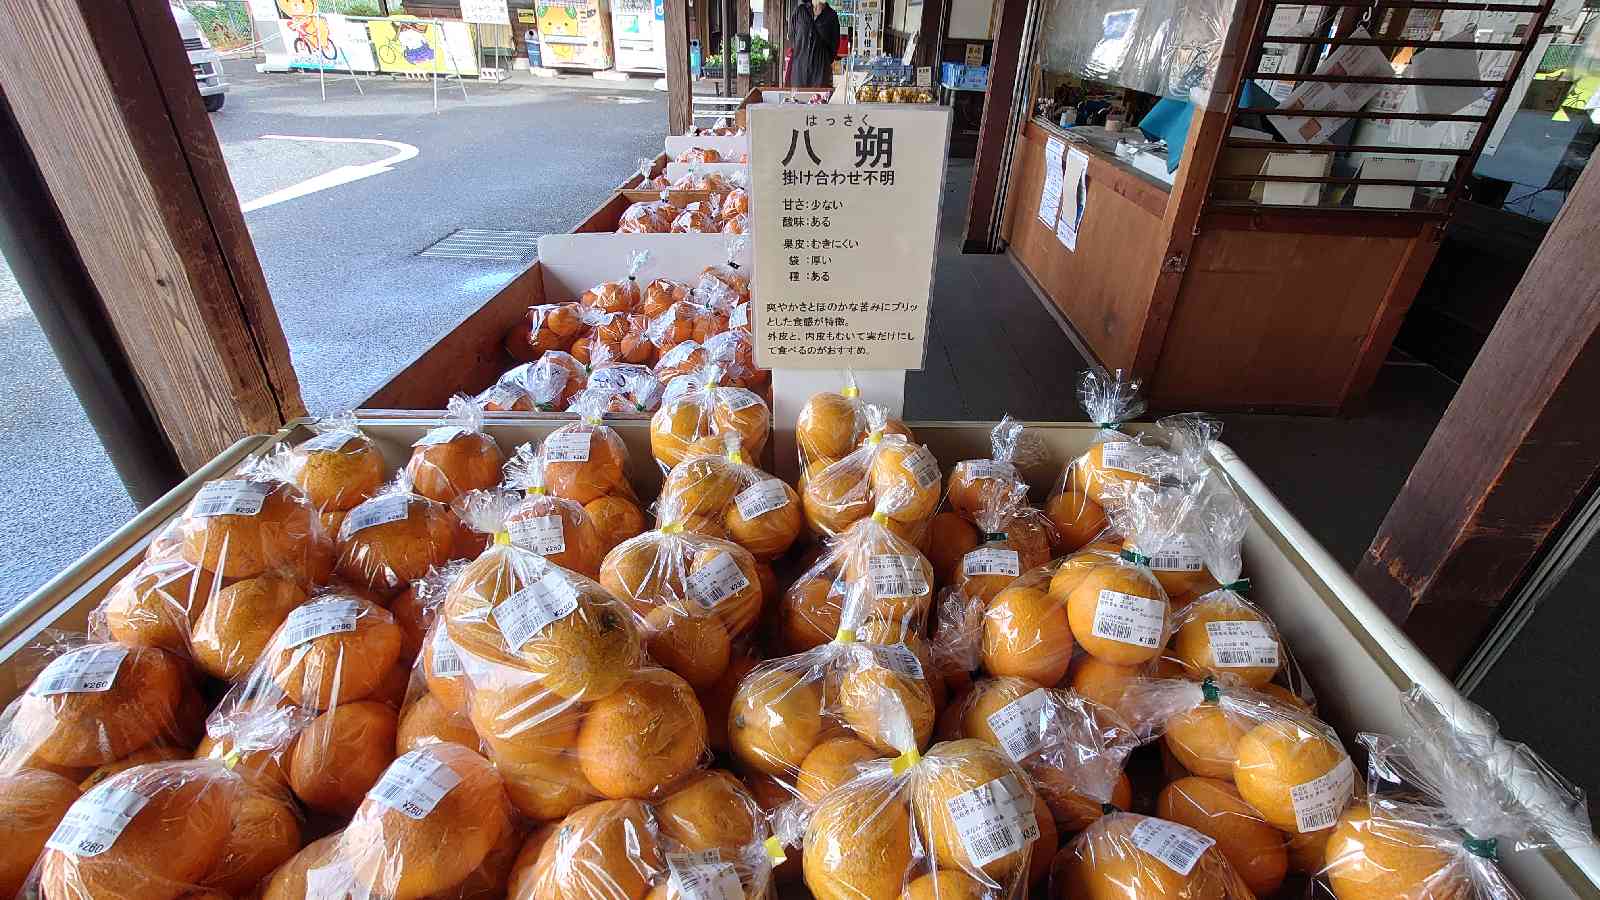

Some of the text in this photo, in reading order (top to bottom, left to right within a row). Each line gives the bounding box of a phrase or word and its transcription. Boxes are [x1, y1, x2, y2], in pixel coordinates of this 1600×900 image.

[806, 114, 869, 127] はっさく
[781, 126, 894, 168] 八朔
[782, 170, 895, 186] 掛け合わせ不明
[782, 199, 844, 211] 甘さ:少ない
[782, 216, 831, 228] 酸味:ある
[783, 238, 859, 250] 果皮:むきにくい
[766, 317, 850, 328] とした食感が特徴。
[767, 332, 915, 342] 外皮と、内皮もむいて実だけにし
[768, 346, 870, 356] て食べるのがおすすめ。
